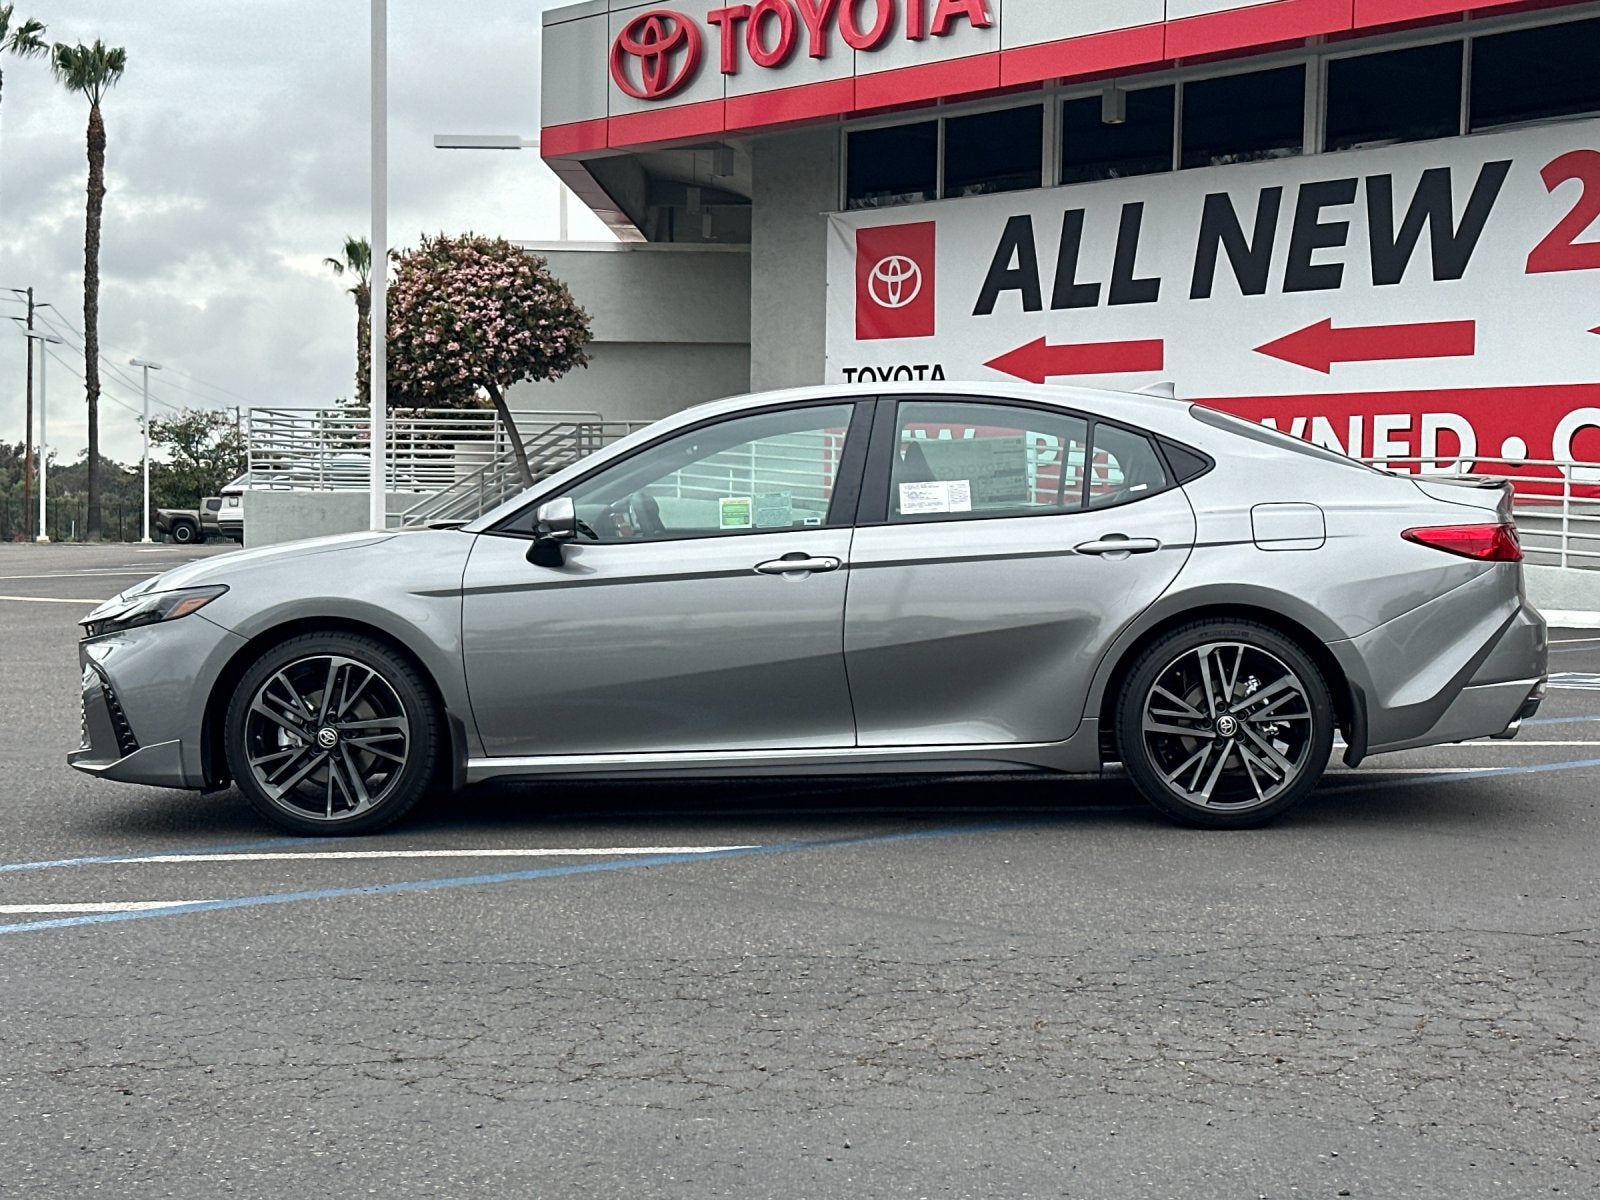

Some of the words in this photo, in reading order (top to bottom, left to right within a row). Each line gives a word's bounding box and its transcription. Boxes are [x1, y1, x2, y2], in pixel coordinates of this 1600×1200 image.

[972, 202, 1161, 316] ALL
[1189, 159, 1513, 299] NEW
[842, 364, 945, 383] TOYOTA
